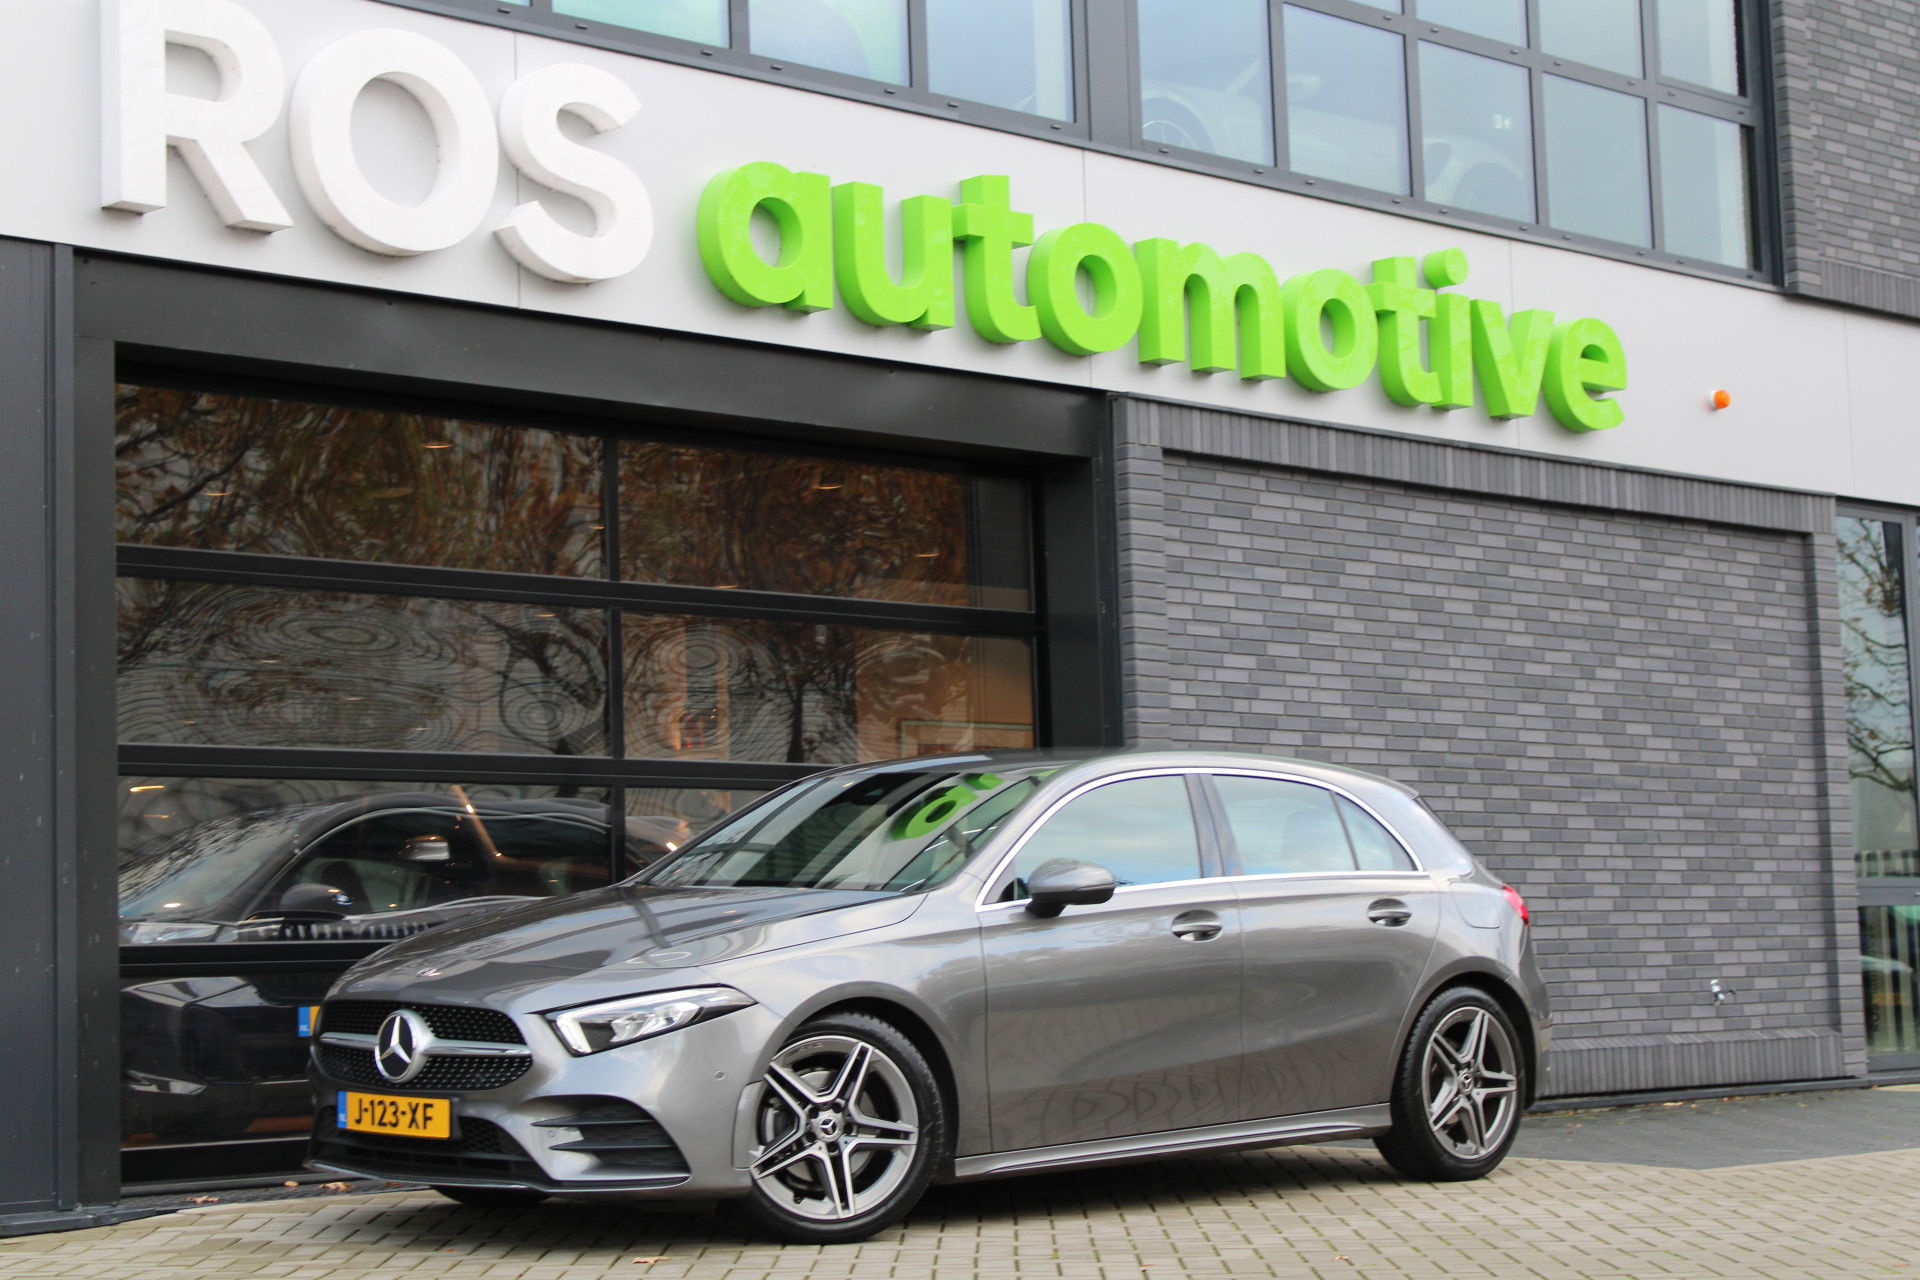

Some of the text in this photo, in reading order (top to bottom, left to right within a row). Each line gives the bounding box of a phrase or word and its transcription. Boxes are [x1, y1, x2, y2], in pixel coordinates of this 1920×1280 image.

[100, 0, 1625, 432] ROS automotive
[353, 1098, 434, 1130] J-123-XF
